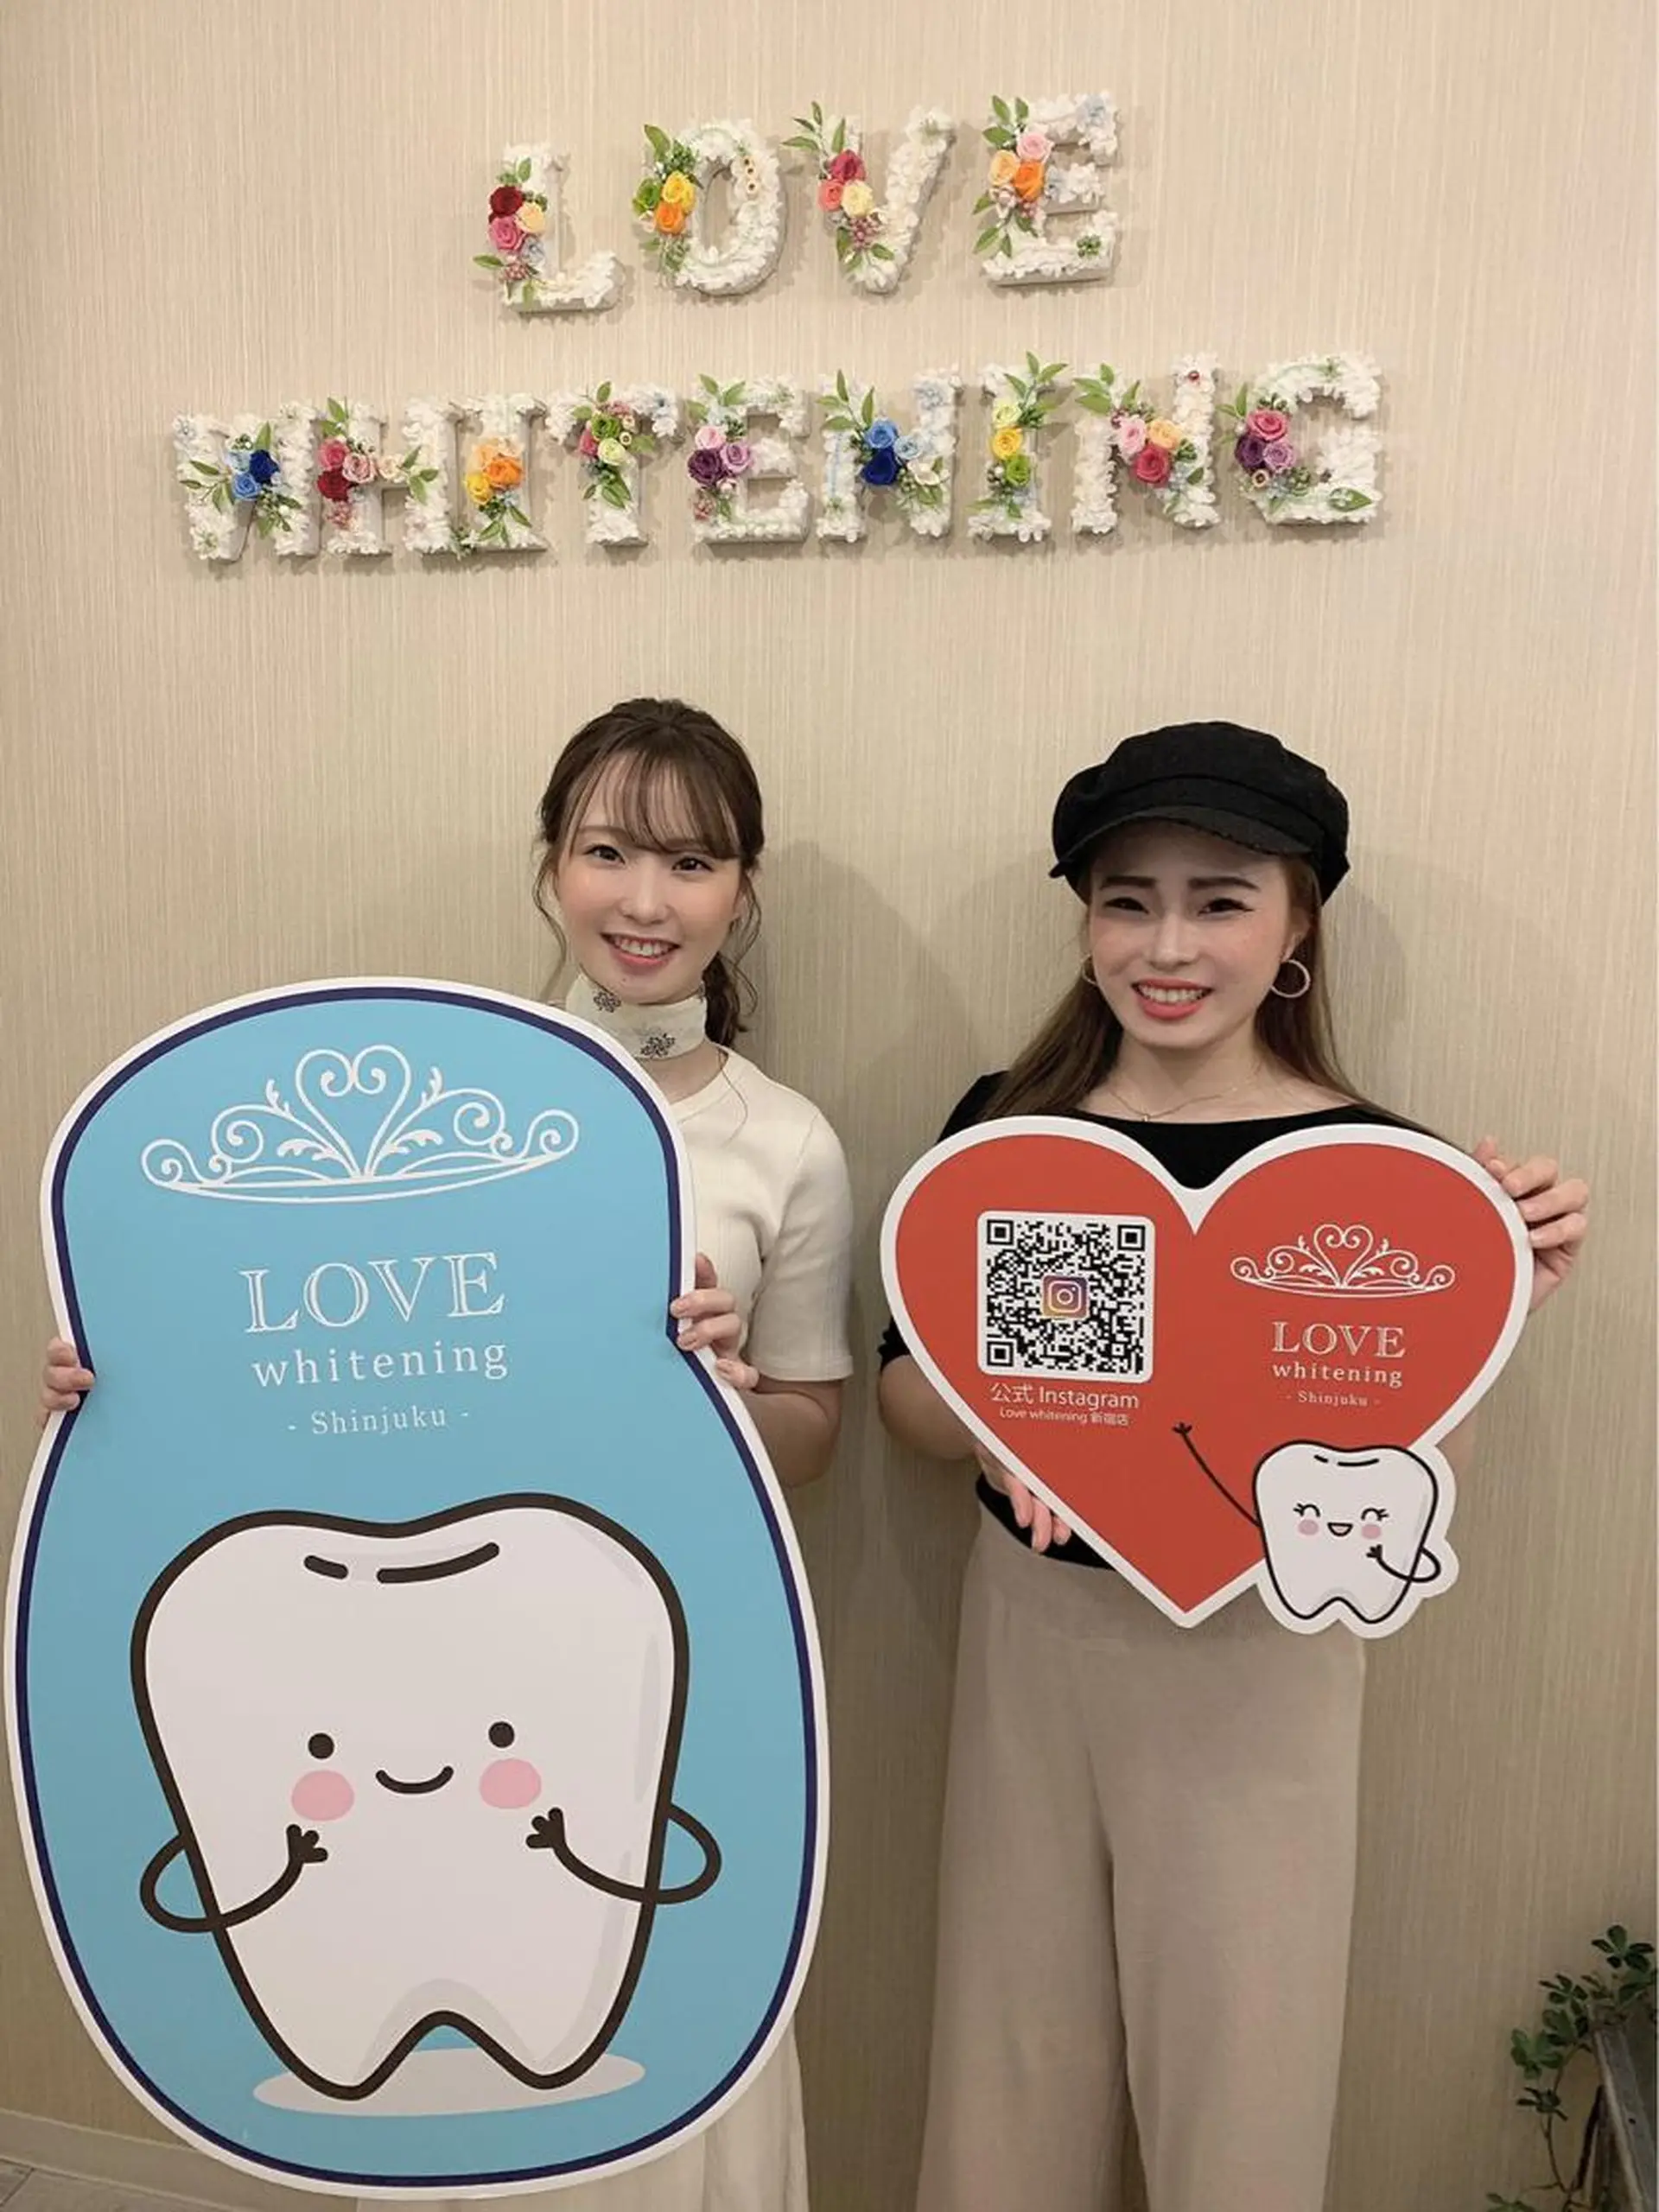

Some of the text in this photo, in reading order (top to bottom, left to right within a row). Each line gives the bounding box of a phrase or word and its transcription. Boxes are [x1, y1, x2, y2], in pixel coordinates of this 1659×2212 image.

[486, 92, 1121, 313] LOVE
[173, 353, 1382, 563] WHITENING
[238, 1251, 505, 1333] LOVE
[1271, 1320, 1406, 1358] LOVE
[251, 1340, 508, 1387] whitening
[1272, 1361, 1402, 1389] whitening
[990, 1382, 1140, 1410] 公式 Instagram
[310, 1405, 447, 1434] Shinjuku
[1000, 1407, 1027, 1420] Love
[1029, 1409, 1088, 1424] whitening
